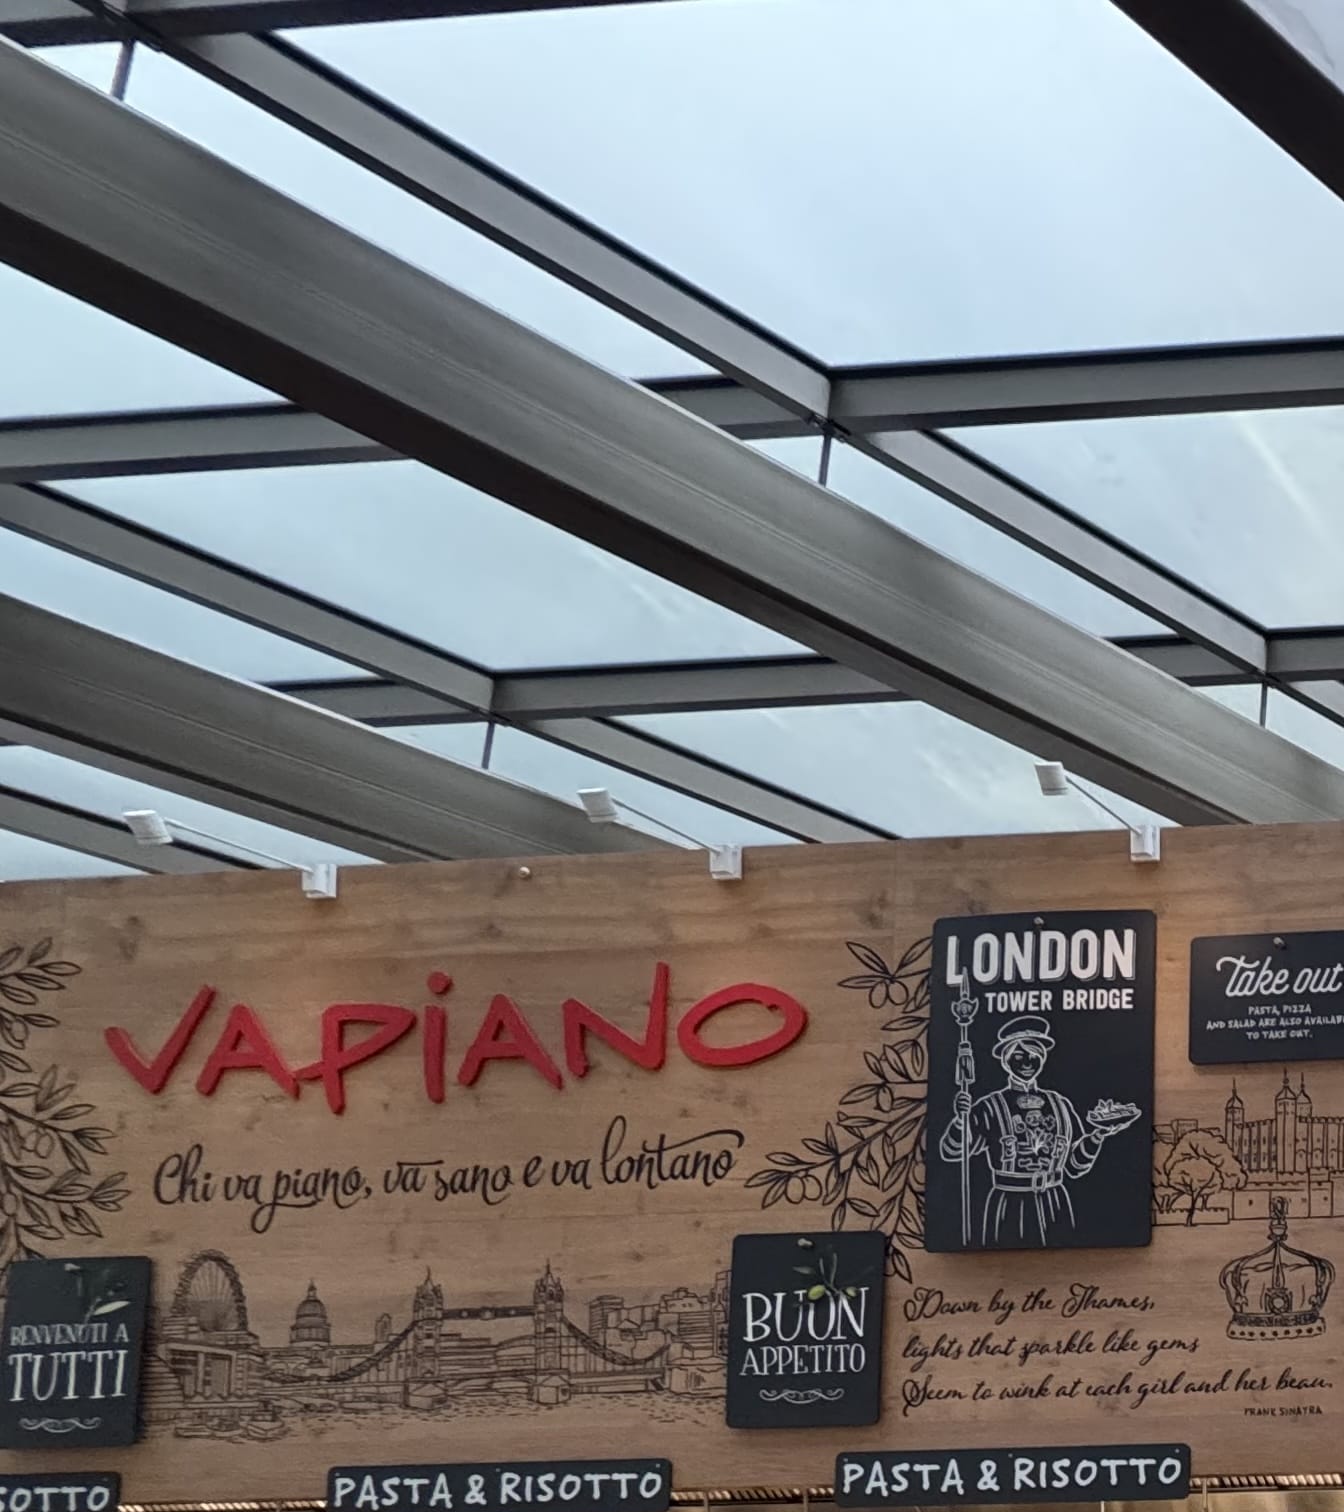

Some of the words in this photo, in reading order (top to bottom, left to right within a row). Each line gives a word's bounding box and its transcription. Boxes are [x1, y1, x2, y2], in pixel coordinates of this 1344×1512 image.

[946, 929, 1136, 985] LONDON
[1215, 955, 1290, 998] Take
[1293, 963, 1344, 994] out
[984, 990, 1052, 1013] TOWER
[1062, 988, 1134, 1010] BRIDGE
[1248, 1005, 1280, 1016] PASTA,
[1282, 1004, 1312, 1014] PIZZA
[1206, 1020, 1226, 1030] AND
[1227, 1019, 1256, 1029] SALAD
[1258, 1018, 1277, 1028] ARE
[1279, 1017, 1301, 1027] ALSO
[1246, 1031, 1260, 1040] TO
[1262, 1030, 1287, 1039] TAKE
[154, 1144, 211, 1204] Chi
[225, 1173, 262, 1201] va
[251, 1166, 373, 1233] piano,
[434, 1160, 513, 1205] sano
[523, 1155, 543, 1189] e
[552, 1157, 592, 1190] va
[599, 1115, 745, 1190] lontano
[742, 1287, 870, 1342] BUON
[987, 1288, 1016, 1325] by
[1021, 1288, 1055, 1313] the
[1061, 1282, 1155, 1318] Thames,
[10, 1323, 108, 1346] BENVENUTI
[114, 1323, 129, 1343] A
[902, 1333, 962, 1372] lights
[967, 1332, 1017, 1358] that
[1018, 1329, 1096, 1367] sparkle
[1102, 1329, 1138, 1353] like
[1139, 1337, 1200, 1365] gems
[8, 1350, 128, 1401] TUTTI
[739, 1343, 866, 1376] APPETITO
[902, 1374, 967, 1417] Seem
[972, 1378, 994, 1401] to
[999, 1372, 1050, 1401] wink
[1055, 1377, 1080, 1398] at
[1086, 1372, 1131, 1398] each
[1130, 1371, 1186, 1409] girl
[1184, 1369, 1230, 1395] and
[1233, 1369, 1271, 1392] her
[1243, 1407, 1277, 1418] FRANK
[1279, 1405, 1323, 1417] SINATRA
[333, 1473, 453, 1511] PASTA
[465, 1475, 487, 1505] &
[500, 1471, 662, 1505] RISOTTO
[843, 1458, 964, 1497] PASTA
[976, 1460, 1000, 1492] &
[1014, 1457, 1182, 1491] RISOTTO
